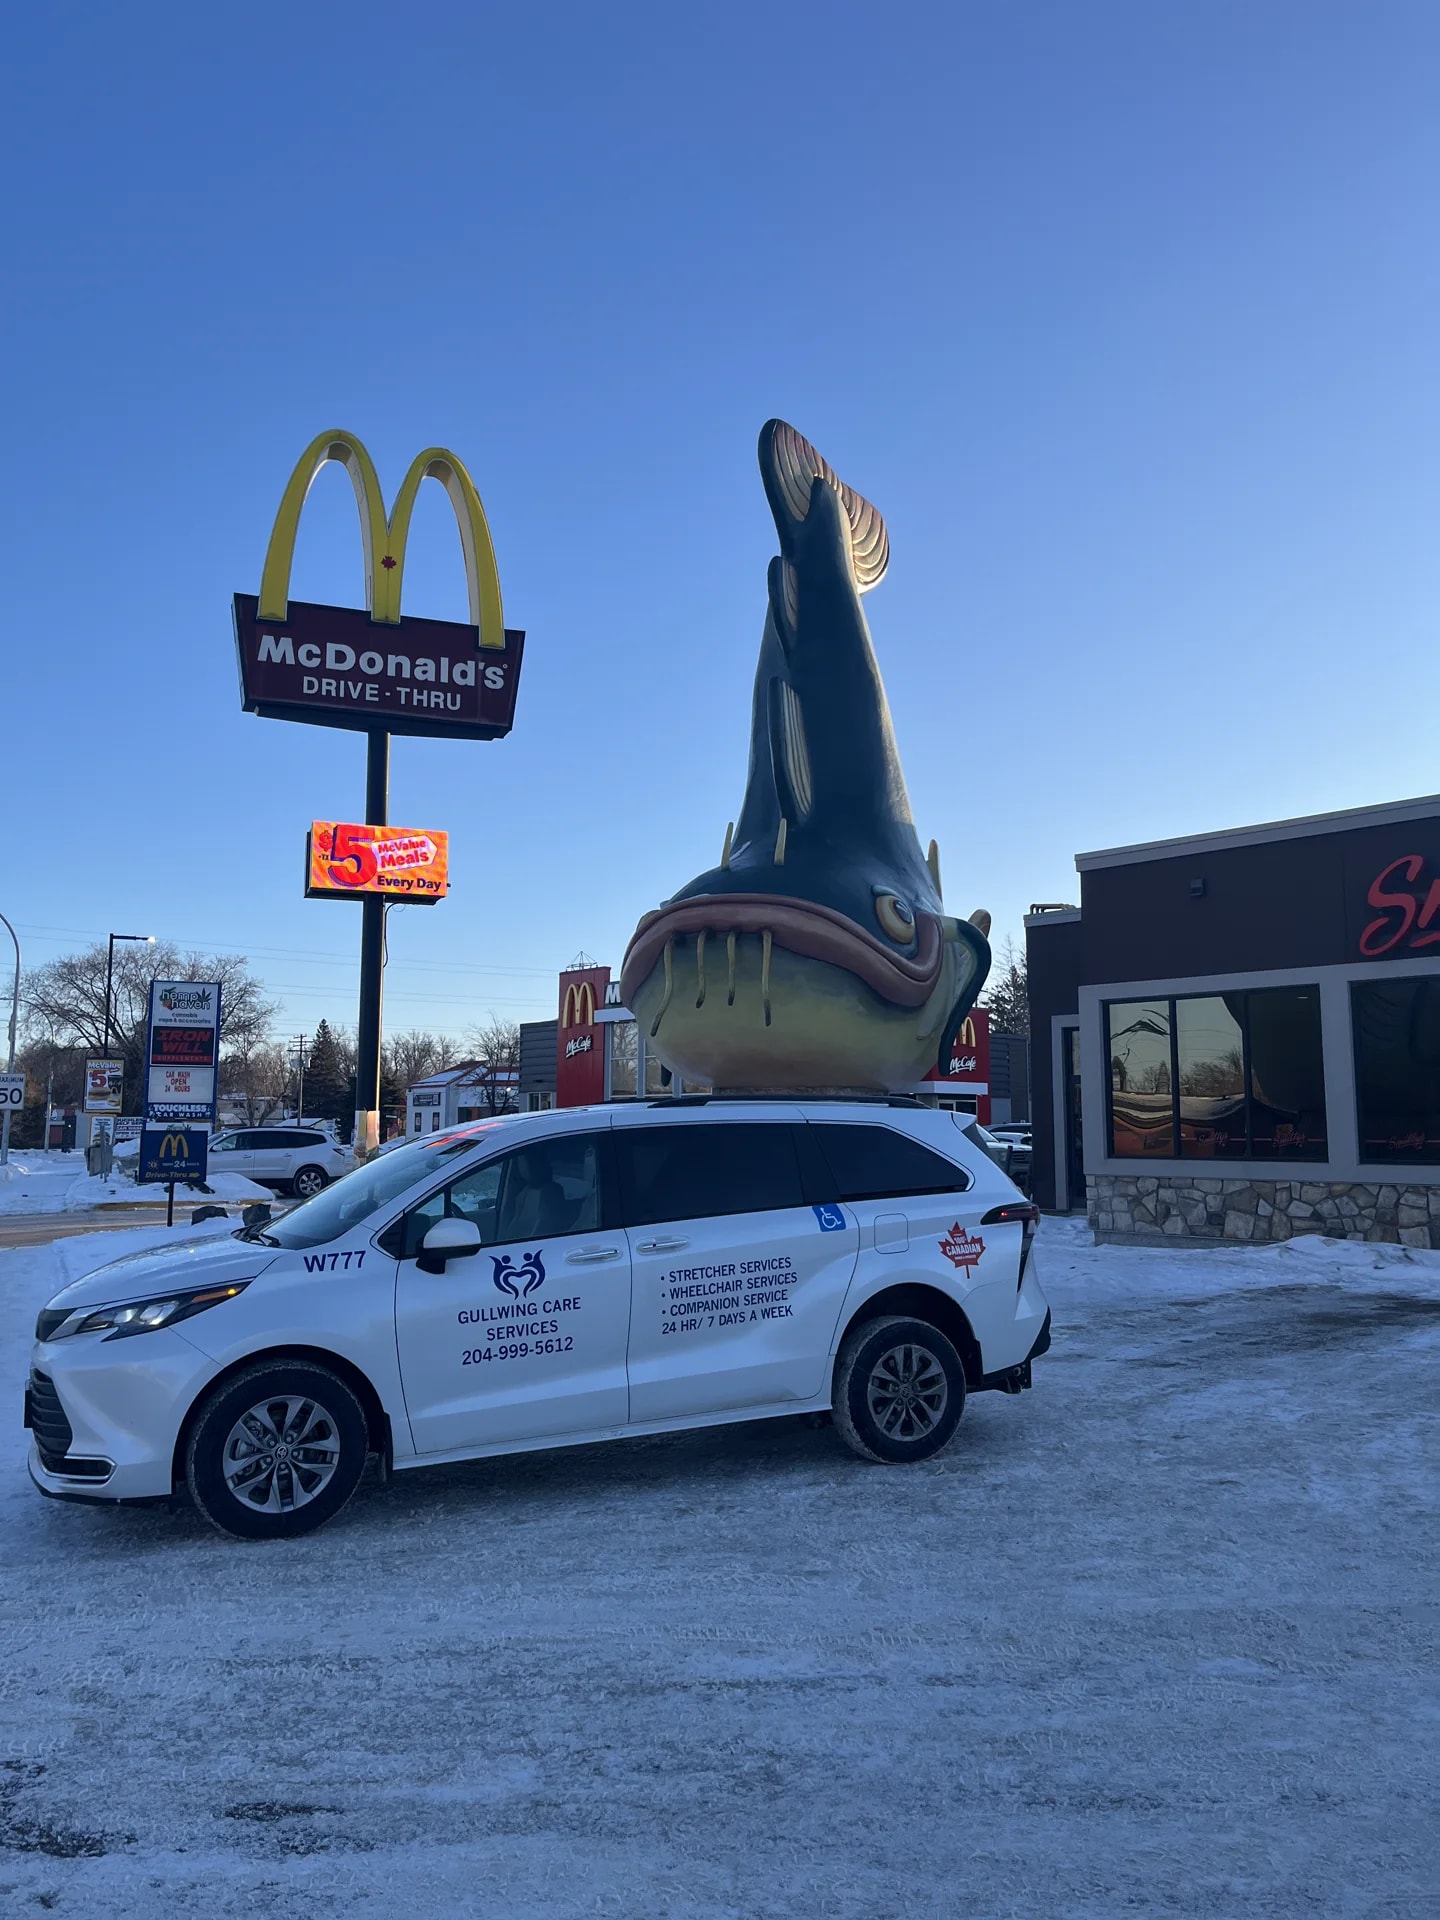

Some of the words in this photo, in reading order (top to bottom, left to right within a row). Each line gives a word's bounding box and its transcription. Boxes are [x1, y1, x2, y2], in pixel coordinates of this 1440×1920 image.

[257, 635, 506, 690] McDonald's
[378, 839, 426, 854] McValue
[380, 851, 429, 868] Meals
[377, 875, 414, 890] Every
[416, 878, 442, 892] Day
[162, 989, 199, 1001] hemp
[171, 999, 211, 1010] haven
[156, 1030, 211, 1041] IRON
[162, 1042, 204, 1053] WILL
[153, 1104, 207, 1112] TOUCHLESS
[174, 1160, 186, 1168] 24
[945, 1243, 981, 1255] CANADIAN
[303, 1250, 367, 1273] W777
[669, 1264, 736, 1283] STRETCHER
[740, 1256, 792, 1274] SERVICES
[669, 1279, 743, 1300] WHEELCHAIR
[746, 1272, 797, 1289] SERVICES
[457, 1302, 538, 1324] GULLWING
[542, 1297, 581, 1313] CARE
[670, 1296, 739, 1316] COMPANION
[743, 1289, 788, 1306] SERVICE
[661, 1322, 677, 1335] 24
[707, 1316, 715, 1328] 7
[719, 1311, 746, 1326] DAYS
[749, 1309, 758, 1321] A
[761, 1304, 794, 1320] WEEK
[486, 1319, 559, 1341] SERVICES
[461, 1336, 574, 1365] 204-999-5612
